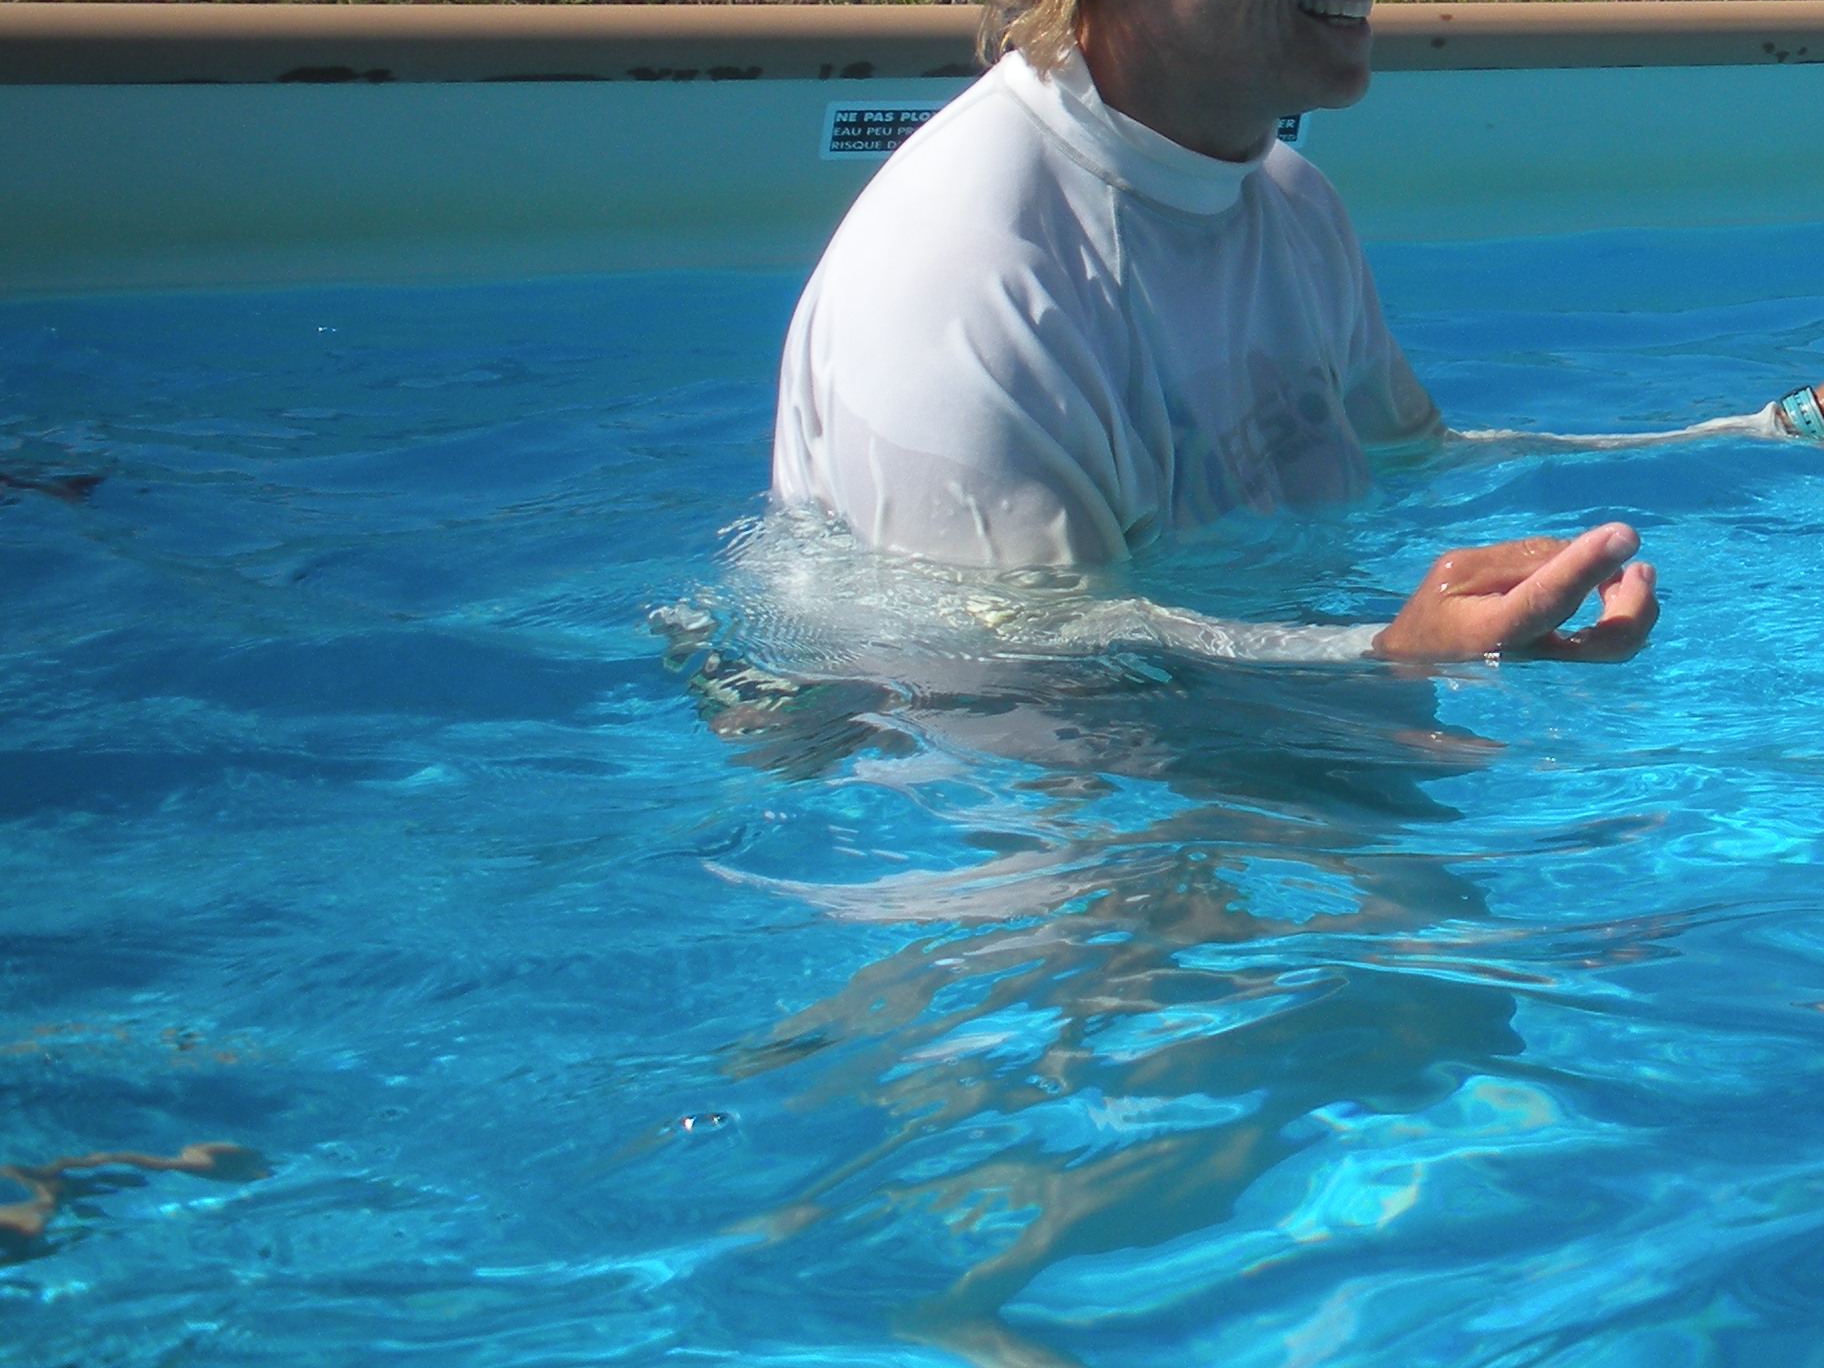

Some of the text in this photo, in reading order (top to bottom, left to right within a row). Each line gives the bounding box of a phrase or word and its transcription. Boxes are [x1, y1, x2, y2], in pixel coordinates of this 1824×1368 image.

[836, 112, 933, 122] NE PAS PLO
[834, 127, 862, 136] EAU
[866, 127, 892, 136] PEU
[831, 141, 882, 150] RISQUE
